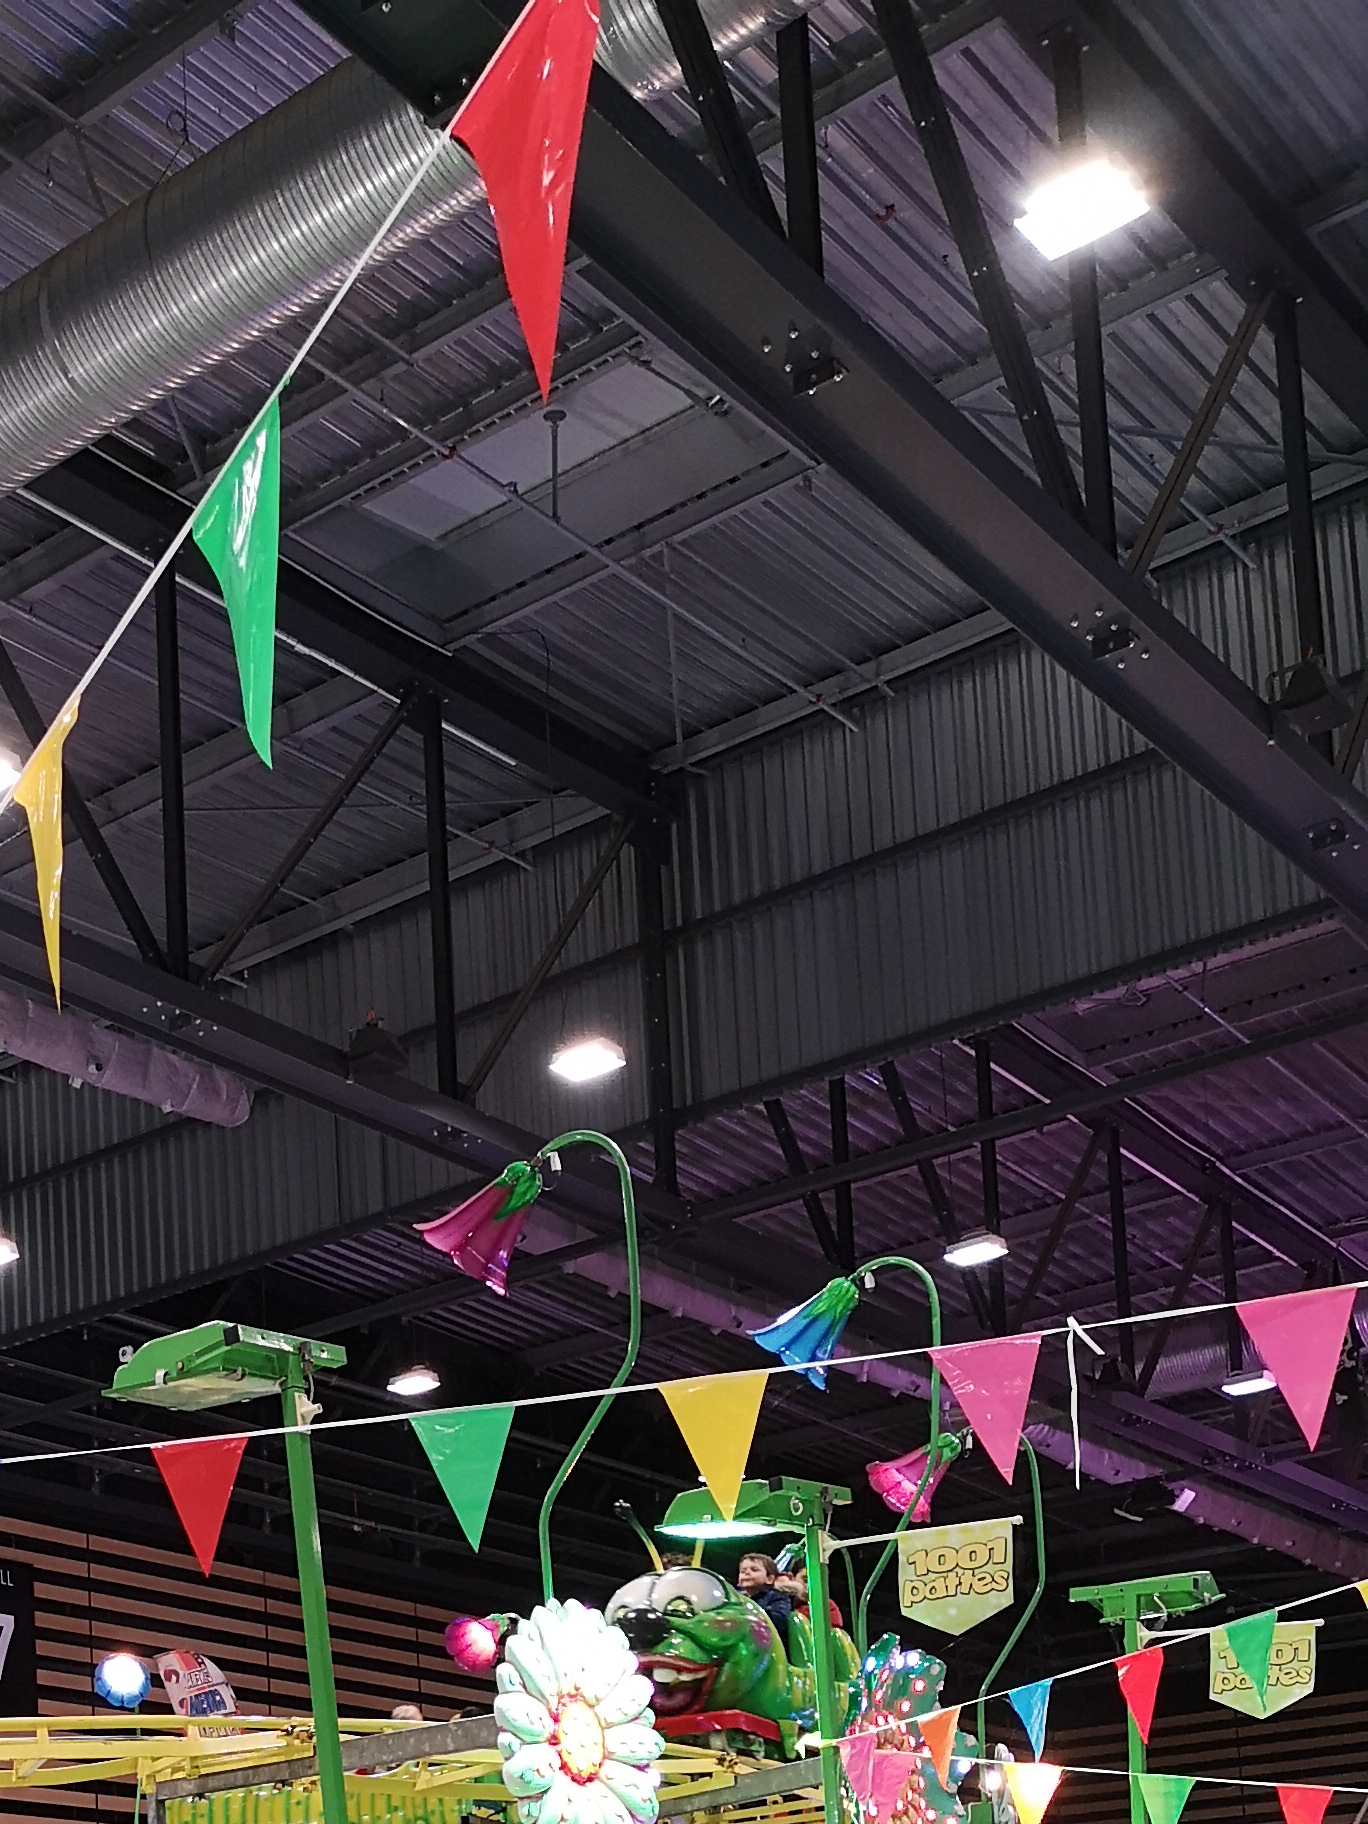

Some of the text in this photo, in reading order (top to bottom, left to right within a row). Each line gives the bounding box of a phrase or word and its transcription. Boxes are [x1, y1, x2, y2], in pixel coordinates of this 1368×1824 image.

[907, 1536, 1007, 1577] 1001
[902, 1569, 1010, 1608] pattes
[1218, 1638, 1311, 1670] 101
[1212, 1664, 1313, 1695] pates
